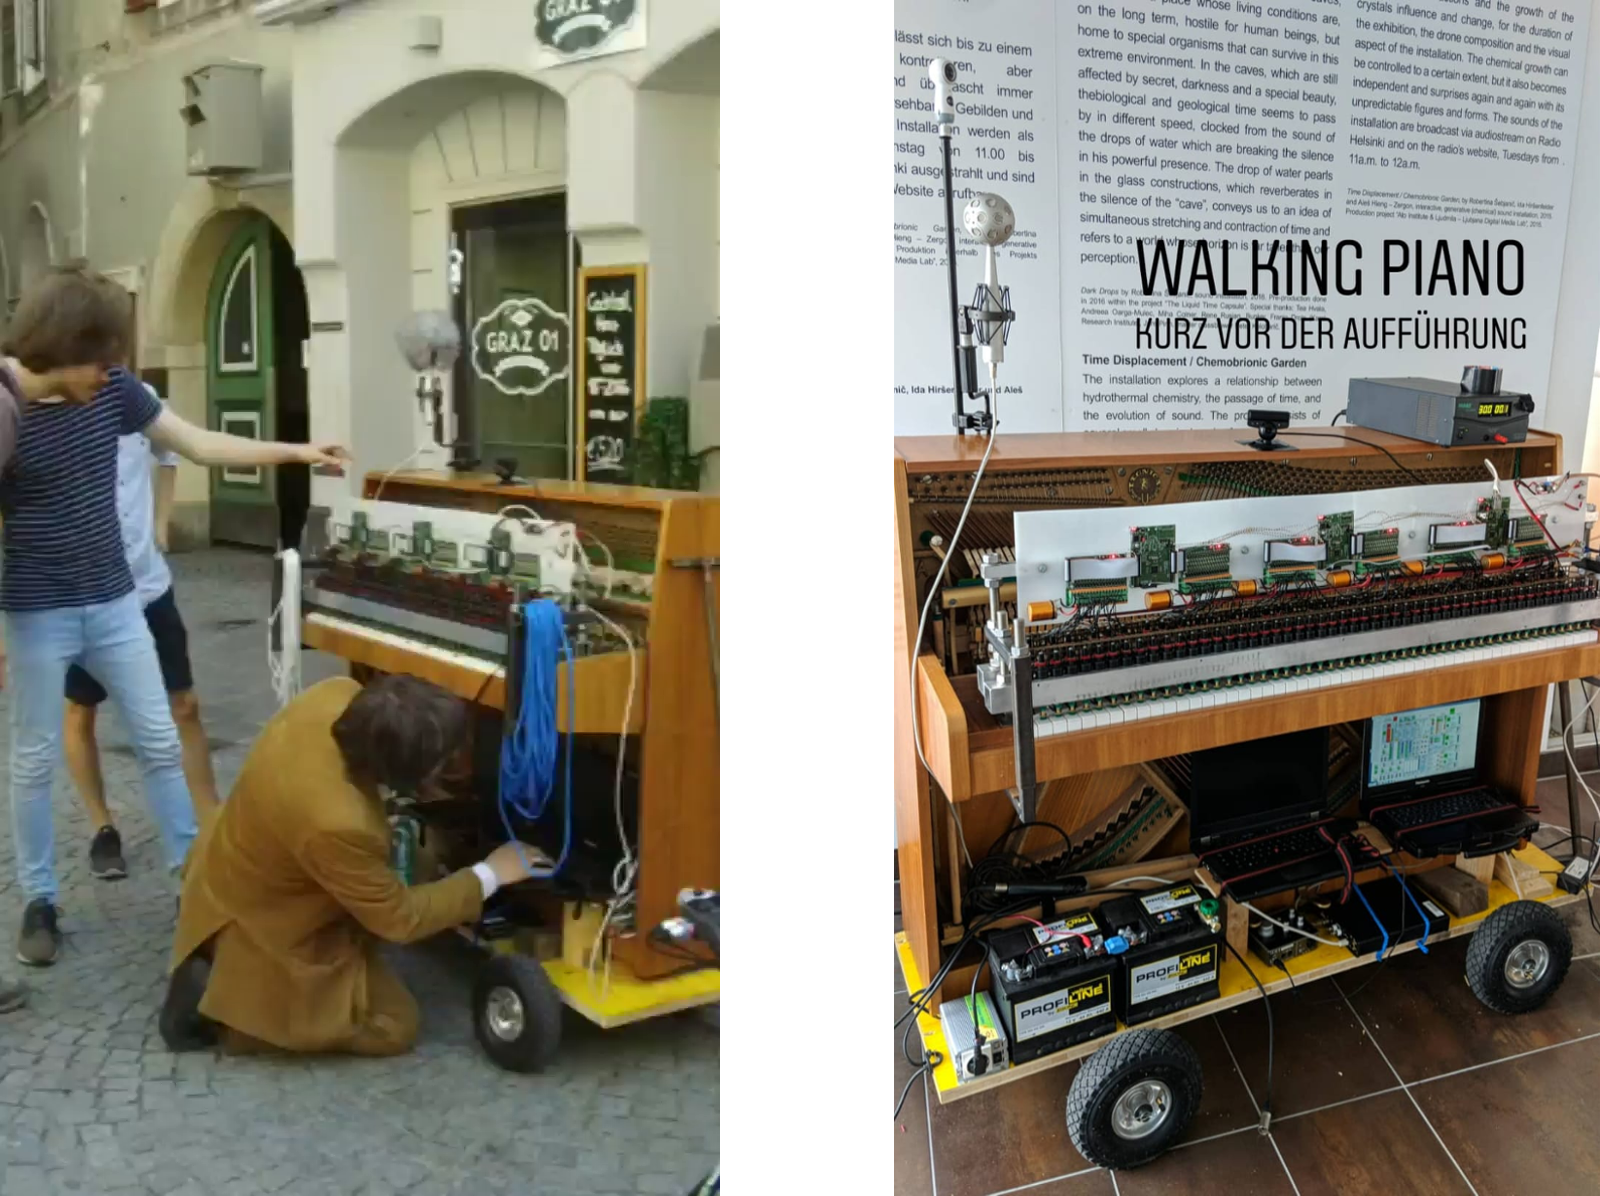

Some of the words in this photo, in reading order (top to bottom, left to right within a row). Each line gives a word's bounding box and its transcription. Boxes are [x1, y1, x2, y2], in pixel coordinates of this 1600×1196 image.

[1078, 4, 1092, 14] on
[1098, 4, 1116, 18] the
[1122, 7, 1146, 24] long
[1152, 12, 1178, 26] term,
[1185, 16, 1219, 30] hostile
[1225, 20, 1238, 32] for
[1244, 22, 1278, 38] human
[1284, 28, 1319, 44] beings,
[1325, 32, 1340, 46] but
[1236, 1, 1262, 18] living
[1267, 6, 1318, 22] conditions
[1322, 14, 1340, 26] are,
[1356, 0, 1392, 12] crystals
[1396, 4, 1437, 20] influence
[1441, 12, 1458, 22] and
[1499, 20, 1510, 30] for
[1512, 22, 1526, 34] the
[1529, 25, 1561, 40] duration
[1564, 30, 1573, 41] of
[895, 29, 923, 44] lässt
[927, 34, 952, 48] sich
[956, 37, 974, 50] bis
[978, 42, 992, 52] zu
[996, 42, 1032, 56] einem
[1006, 65, 1033, 78] aber
[1078, 47, 1122, 61] extreme
[1128, 52, 1196, 69] environment.
[1200, 59, 1210, 70] In
[1214, 60, 1230, 72] the
[1234, 64, 1266, 78] caves,
[1271, 68, 1300, 80] which
[1303, 72, 1319, 83] are
[1322, 74, 1338, 84] still
[997, 84, 1033, 99] immer
[1352, 76, 1408, 93] independent
[1411, 85, 1428, 96] and
[1430, 88, 1469, 100] surprises
[1471, 92, 1494, 105] again
[1496, 96, 1512, 106] and
[1514, 98, 1536, 110] again
[1538, 101, 1554, 112] with
[1556, 103, 1564, 113] its
[956, 102, 1008, 117] Gebilden
[1012, 108, 1033, 120] und
[1078, 88, 1146, 106] thebiological
[1152, 97, 1172, 108] and
[1178, 99, 1230, 114] geological
[1235, 104, 1256, 116] time
[1262, 108, 1294, 120] seems
[1300, 110, 1308, 120] to
[1313, 112, 1336, 124] pass
[968, 126, 1010, 140] werden
[1018, 130, 1034, 142] als
[1351, 115, 1398, 130] installation
[1400, 122, 1414, 132] are
[1417, 122, 1458, 136] broadcast
[1462, 128, 1473, 138] via
[1475, 130, 1524, 144] audiostream
[1526, 136, 1536, 144] on
[1538, 136, 1561, 148] Radio
[975, 148, 1005, 160] 11.00
[1018, 151, 1034, 162] bis
[1078, 130, 1096, 142] the
[1100, 132, 1130, 146] drops
[1135, 135, 1146, 146] of
[1150, 138, 1178, 149] water
[1182, 140, 1212, 152] which
[1216, 144, 1232, 154] are
[1236, 143, 1278, 160] breaking
[1282, 148, 1297, 159] the
[1301, 150, 1334, 162] silence
[1380, 157, 1388, 166] to
[987, 171, 1008, 181] und
[1012, 172, 1034, 183] sind
[1080, 212, 1150, 226] simultaneous
[1152, 216, 1201, 232] stretching
[1203, 220, 1222, 230] and
[1224, 220, 1278, 233] contraction
[1280, 224, 1290, 234] of
[1291, 224, 1310, 235] time
[1314, 226, 1330, 236] and
[486, 330, 533, 353] GRAZ
[539, 330, 559, 352] 01
[1082, 354, 1110, 365] Time
[1114, 354, 1186, 368] Displacement
[1196, 356, 1268, 368] Chemobrionic
[1271, 358, 1307, 368] Garden
[1082, 392, 1148, 404] hydrothermal
[1205, 394, 1220, 403] the
[1224, 395, 1264, 404] passage
[1267, 394, 1276, 403] of
[1304, 394, 1322, 403] and
[1083, 410, 1099, 420] the
[1106, 410, 1150, 420] evolution
[1156, 410, 1166, 420] of
[1210, 410, 1228, 420] The
[1312, 410, 1322, 420] of
